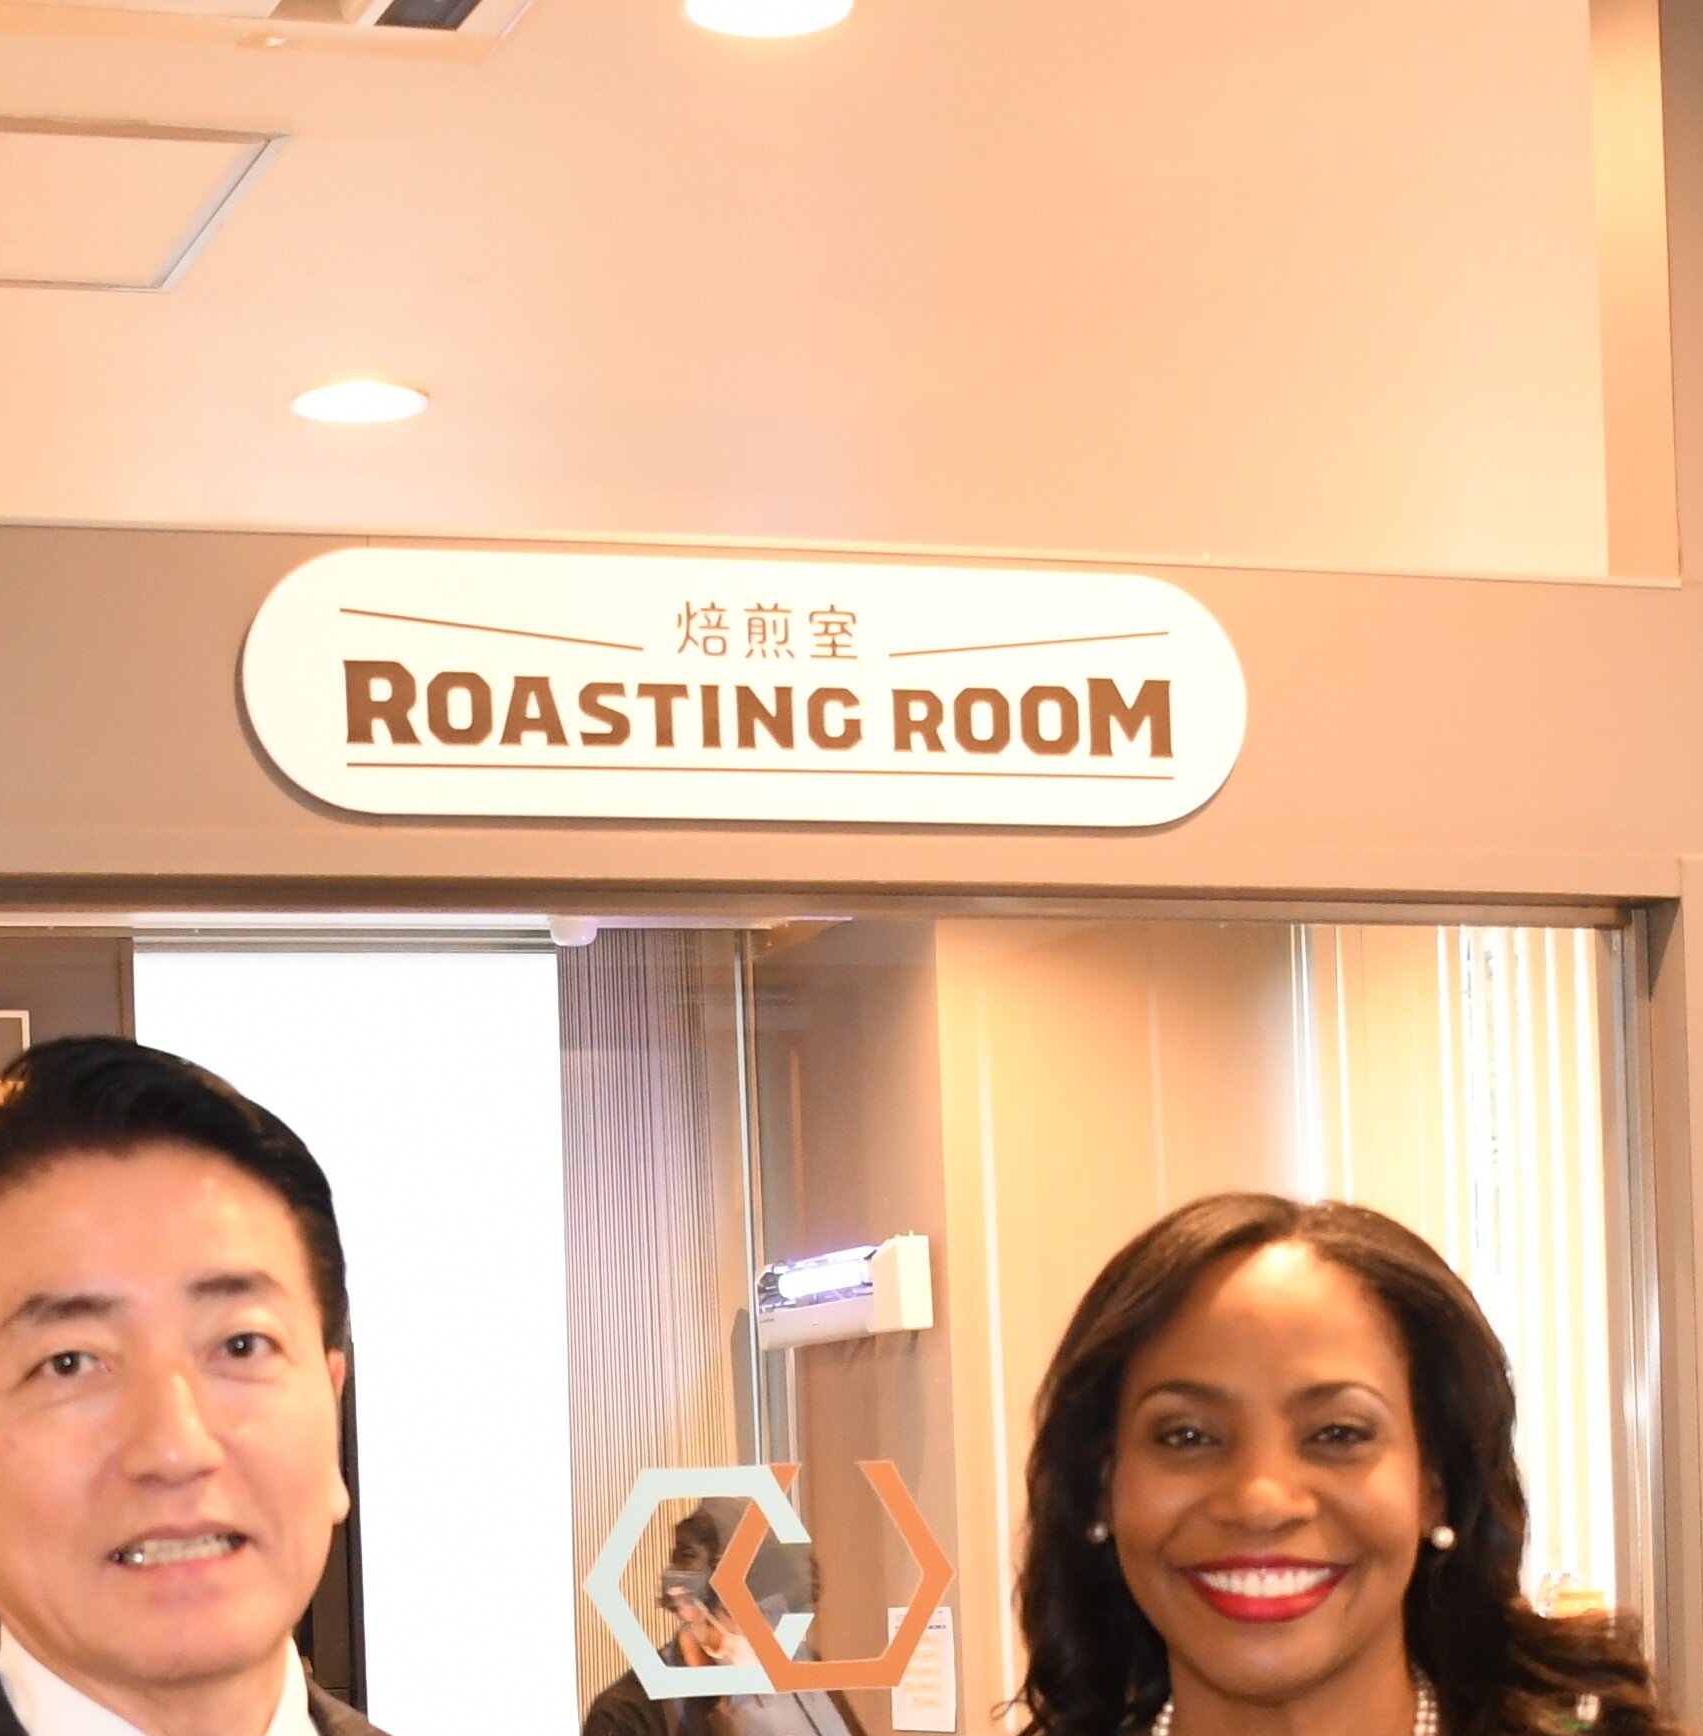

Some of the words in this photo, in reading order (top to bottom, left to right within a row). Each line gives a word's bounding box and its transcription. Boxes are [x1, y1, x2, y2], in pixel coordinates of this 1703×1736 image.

[675, 601, 860, 661] 焙煎室
[342, 659, 864, 753] ROASTING
[892, 677, 1174, 758] ROOM
